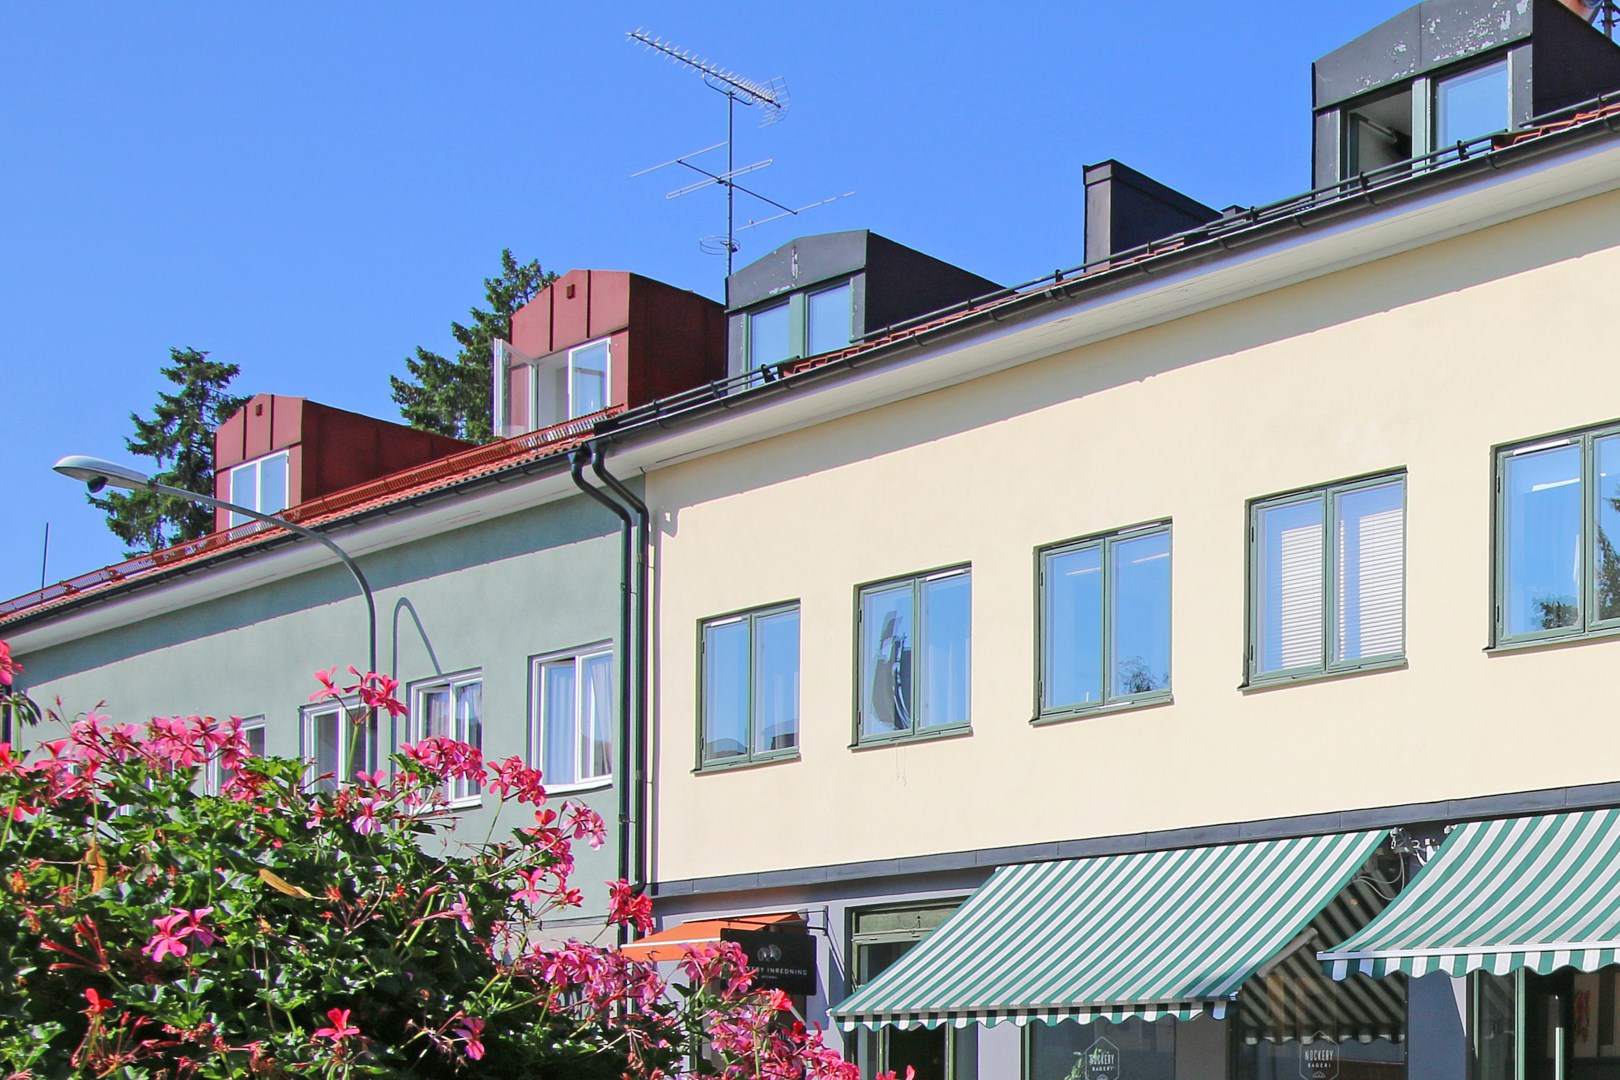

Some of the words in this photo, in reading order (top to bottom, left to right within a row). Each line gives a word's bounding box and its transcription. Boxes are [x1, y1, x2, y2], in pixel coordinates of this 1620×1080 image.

[766, 967, 808, 976] INREDNING
[1089, 1054, 1115, 1065] NOCKEBY
[1304, 1049, 1334, 1061] NOCKEBY
